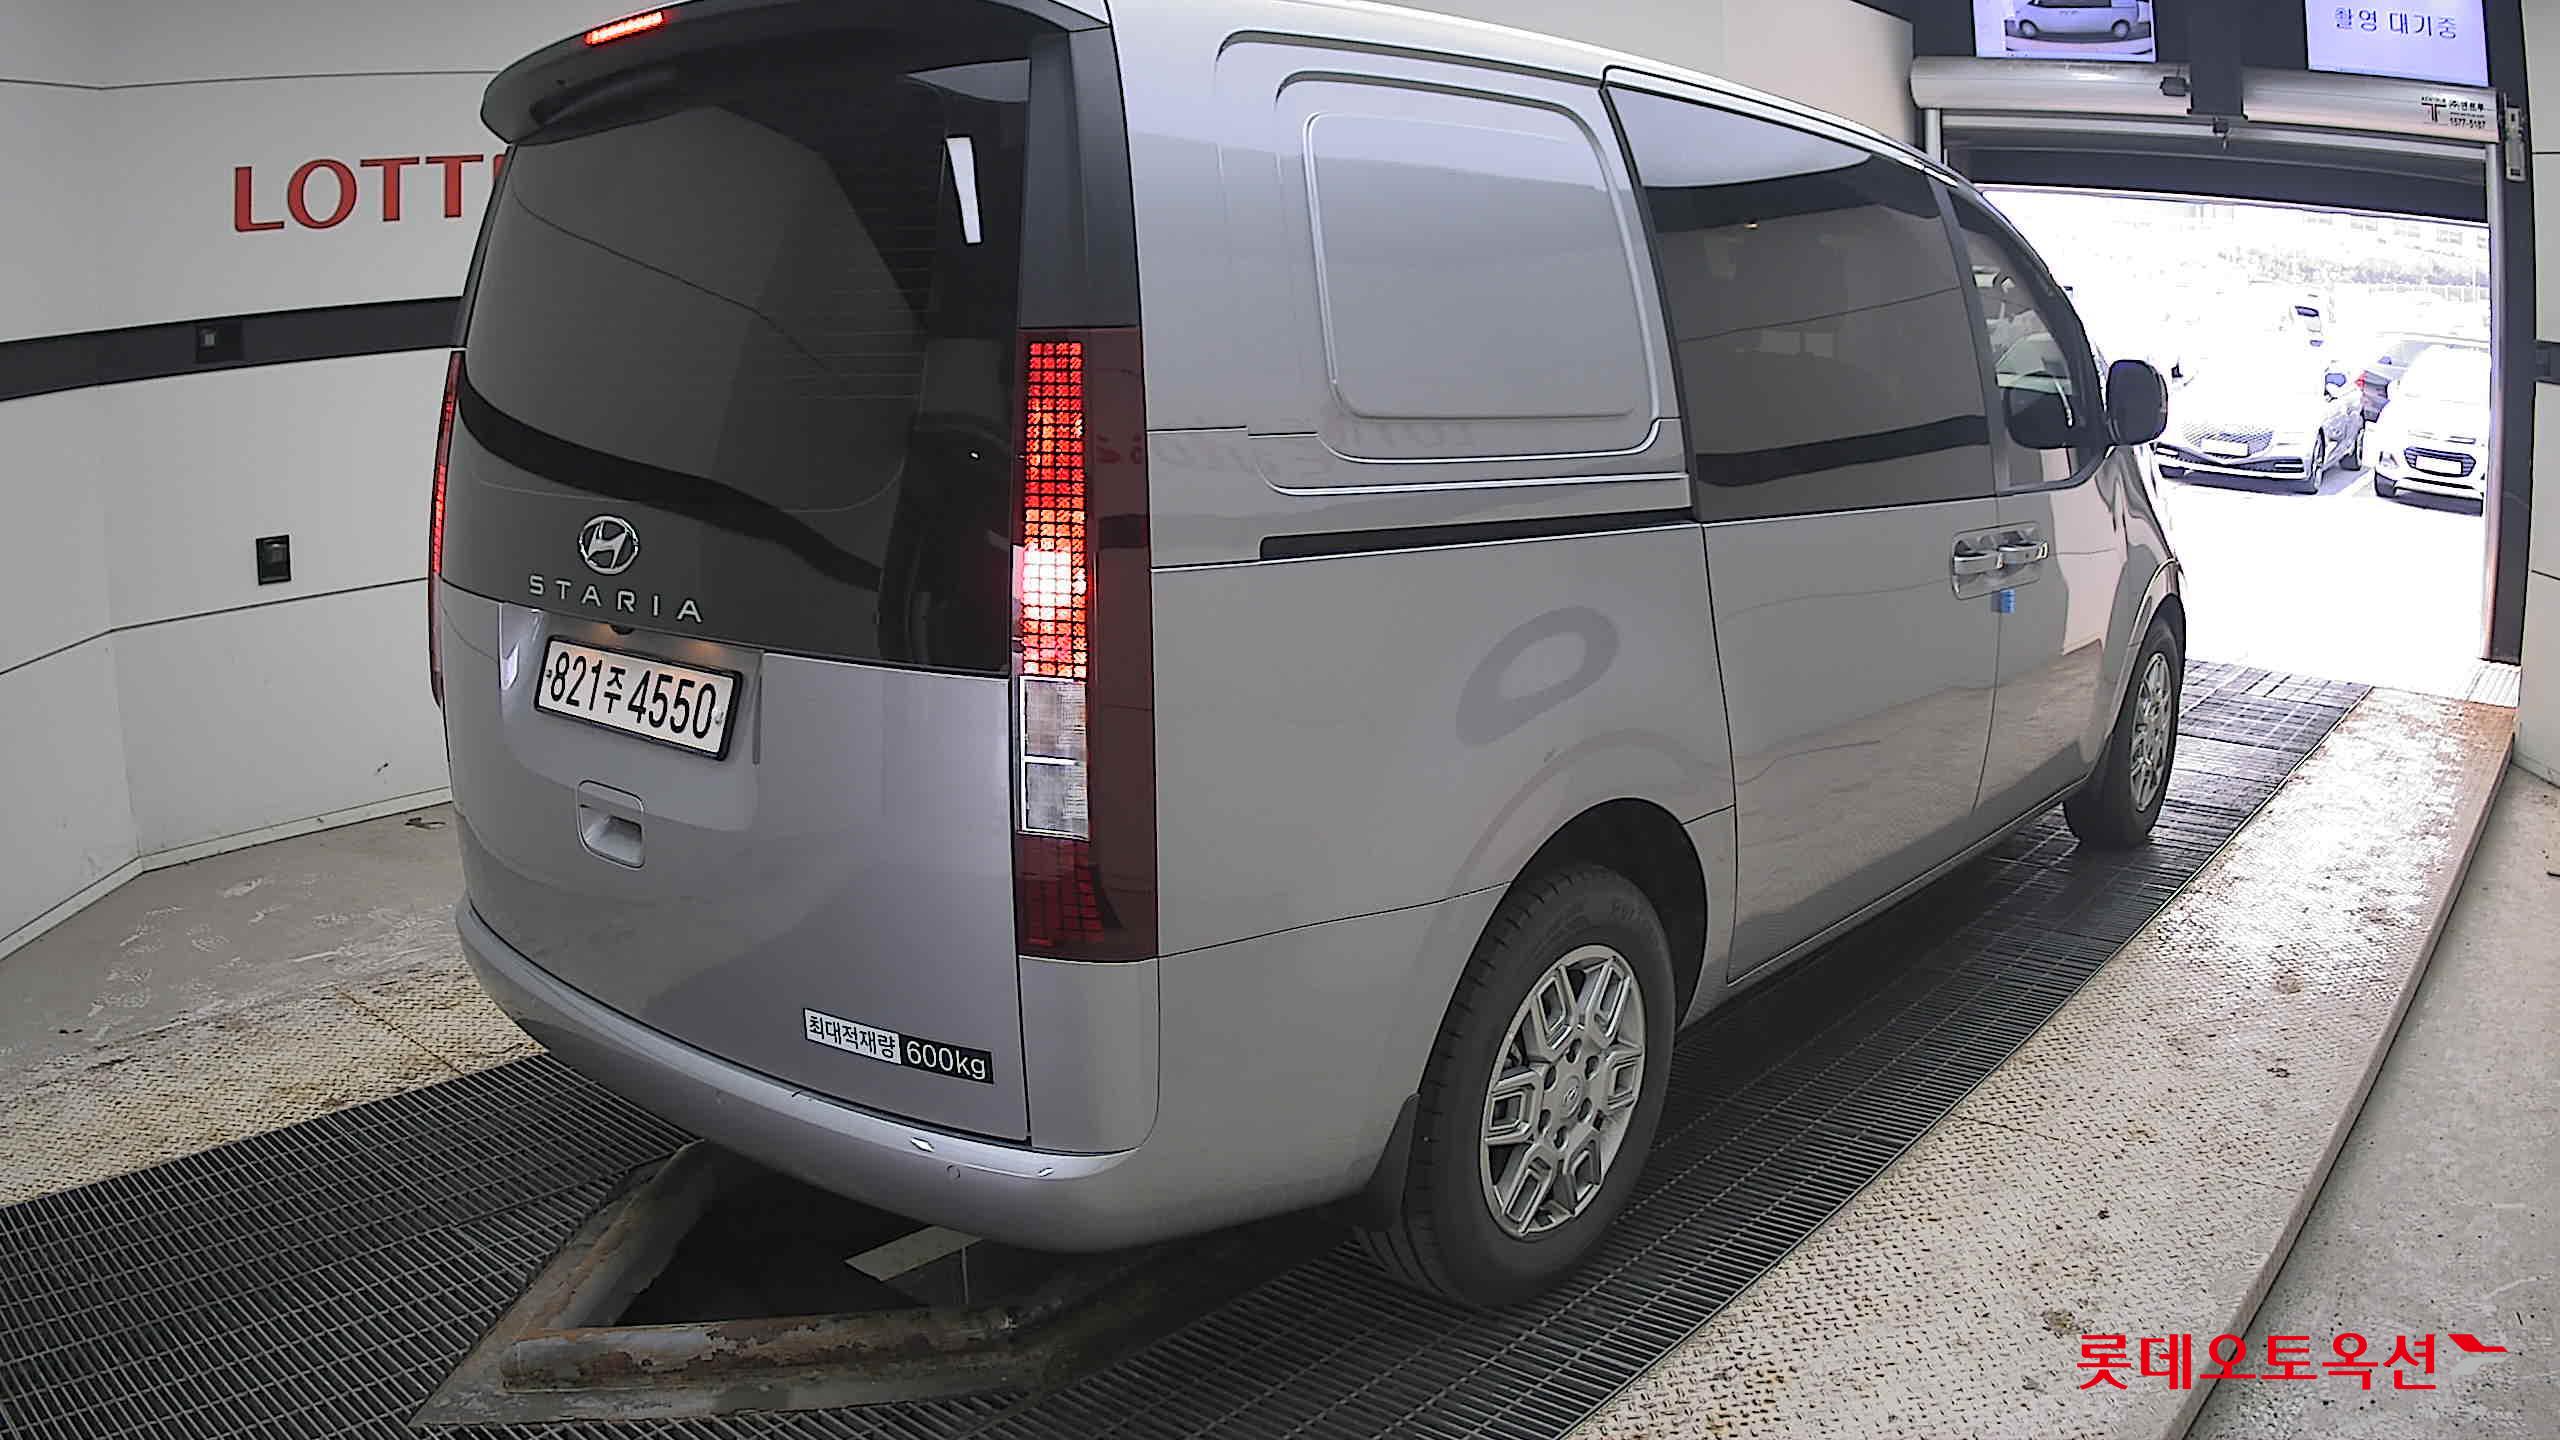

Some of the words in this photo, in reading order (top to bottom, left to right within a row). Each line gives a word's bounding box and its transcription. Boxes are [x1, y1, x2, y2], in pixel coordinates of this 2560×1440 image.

[2389, 12, 2457, 39] 대기중
[234, 153, 506, 232] LOTT
[528, 574, 702, 624] STARIA
[809, 1014, 896, 1059] 최대적재량
[906, 1040, 986, 1080] 600kg
